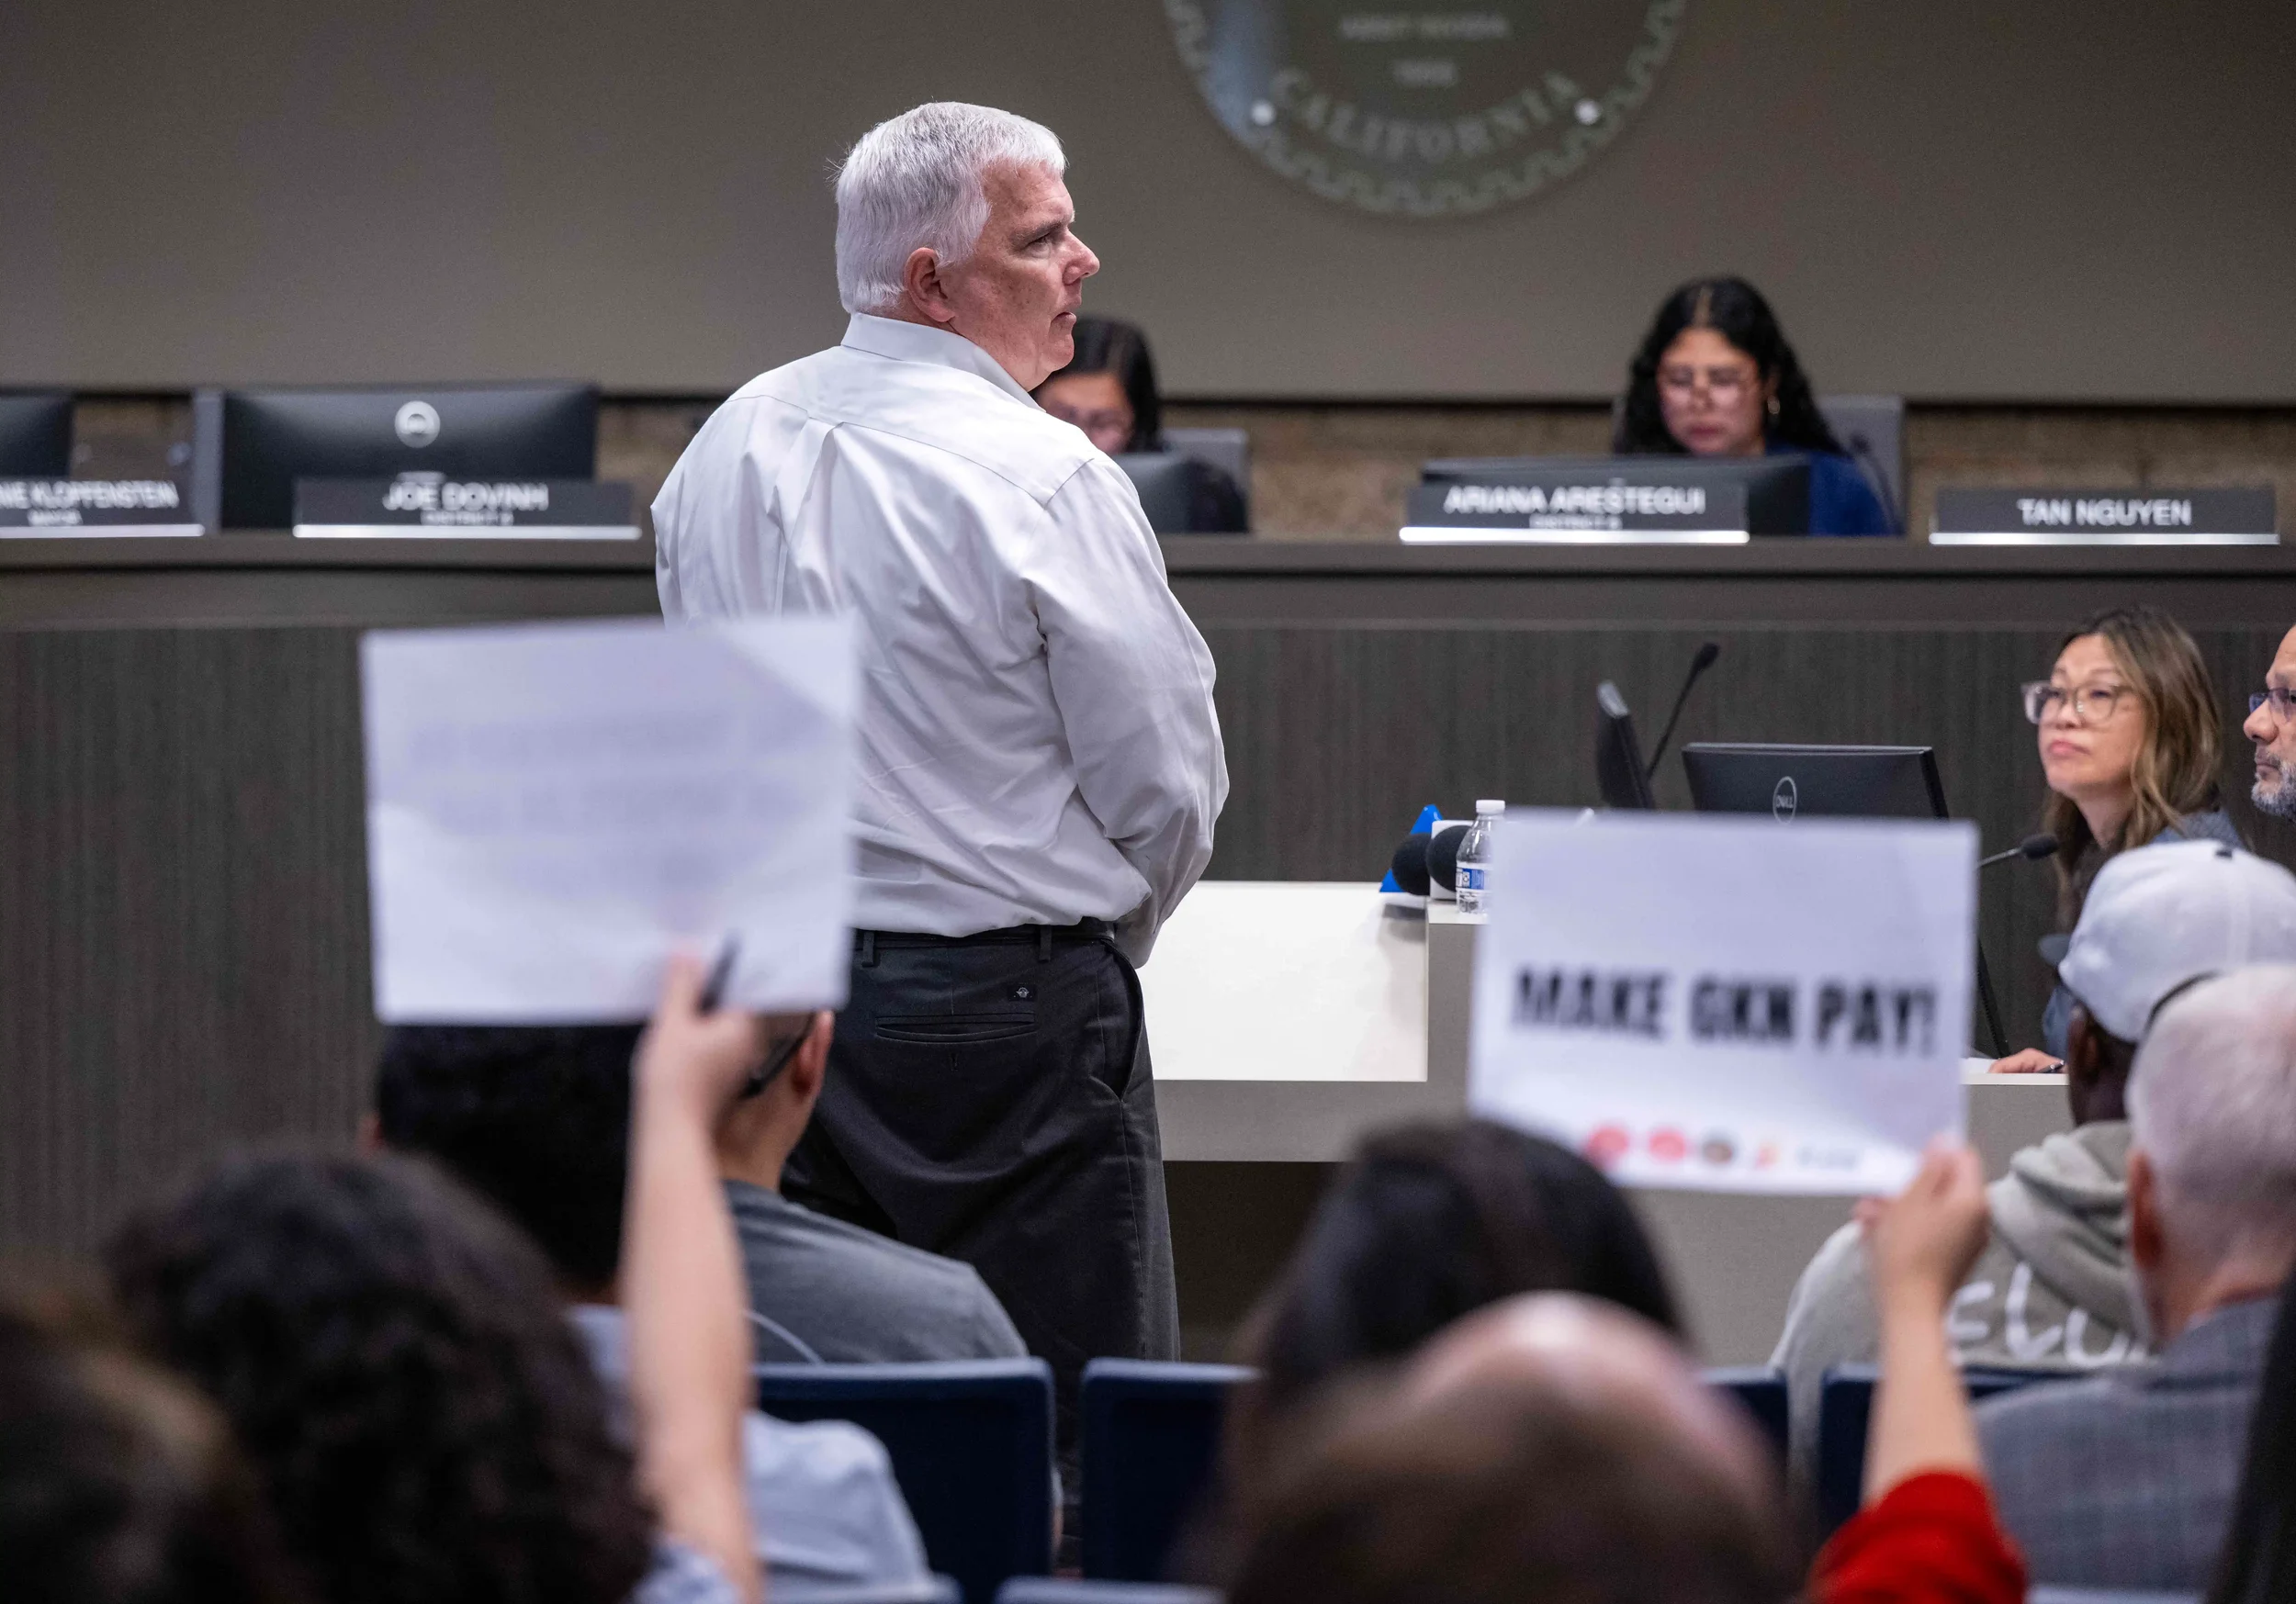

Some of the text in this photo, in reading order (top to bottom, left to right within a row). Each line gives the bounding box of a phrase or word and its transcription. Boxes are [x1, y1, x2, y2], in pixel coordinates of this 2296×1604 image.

[1270, 66, 1581, 163] CALIFORNIA
[383, 481, 441, 510] JOE
[1444, 485, 1548, 514] ARIANA
[2017, 499, 2192, 526] TAN NGUYEN
[1514, 965, 1941, 1056] MAKE GKN PAY!
